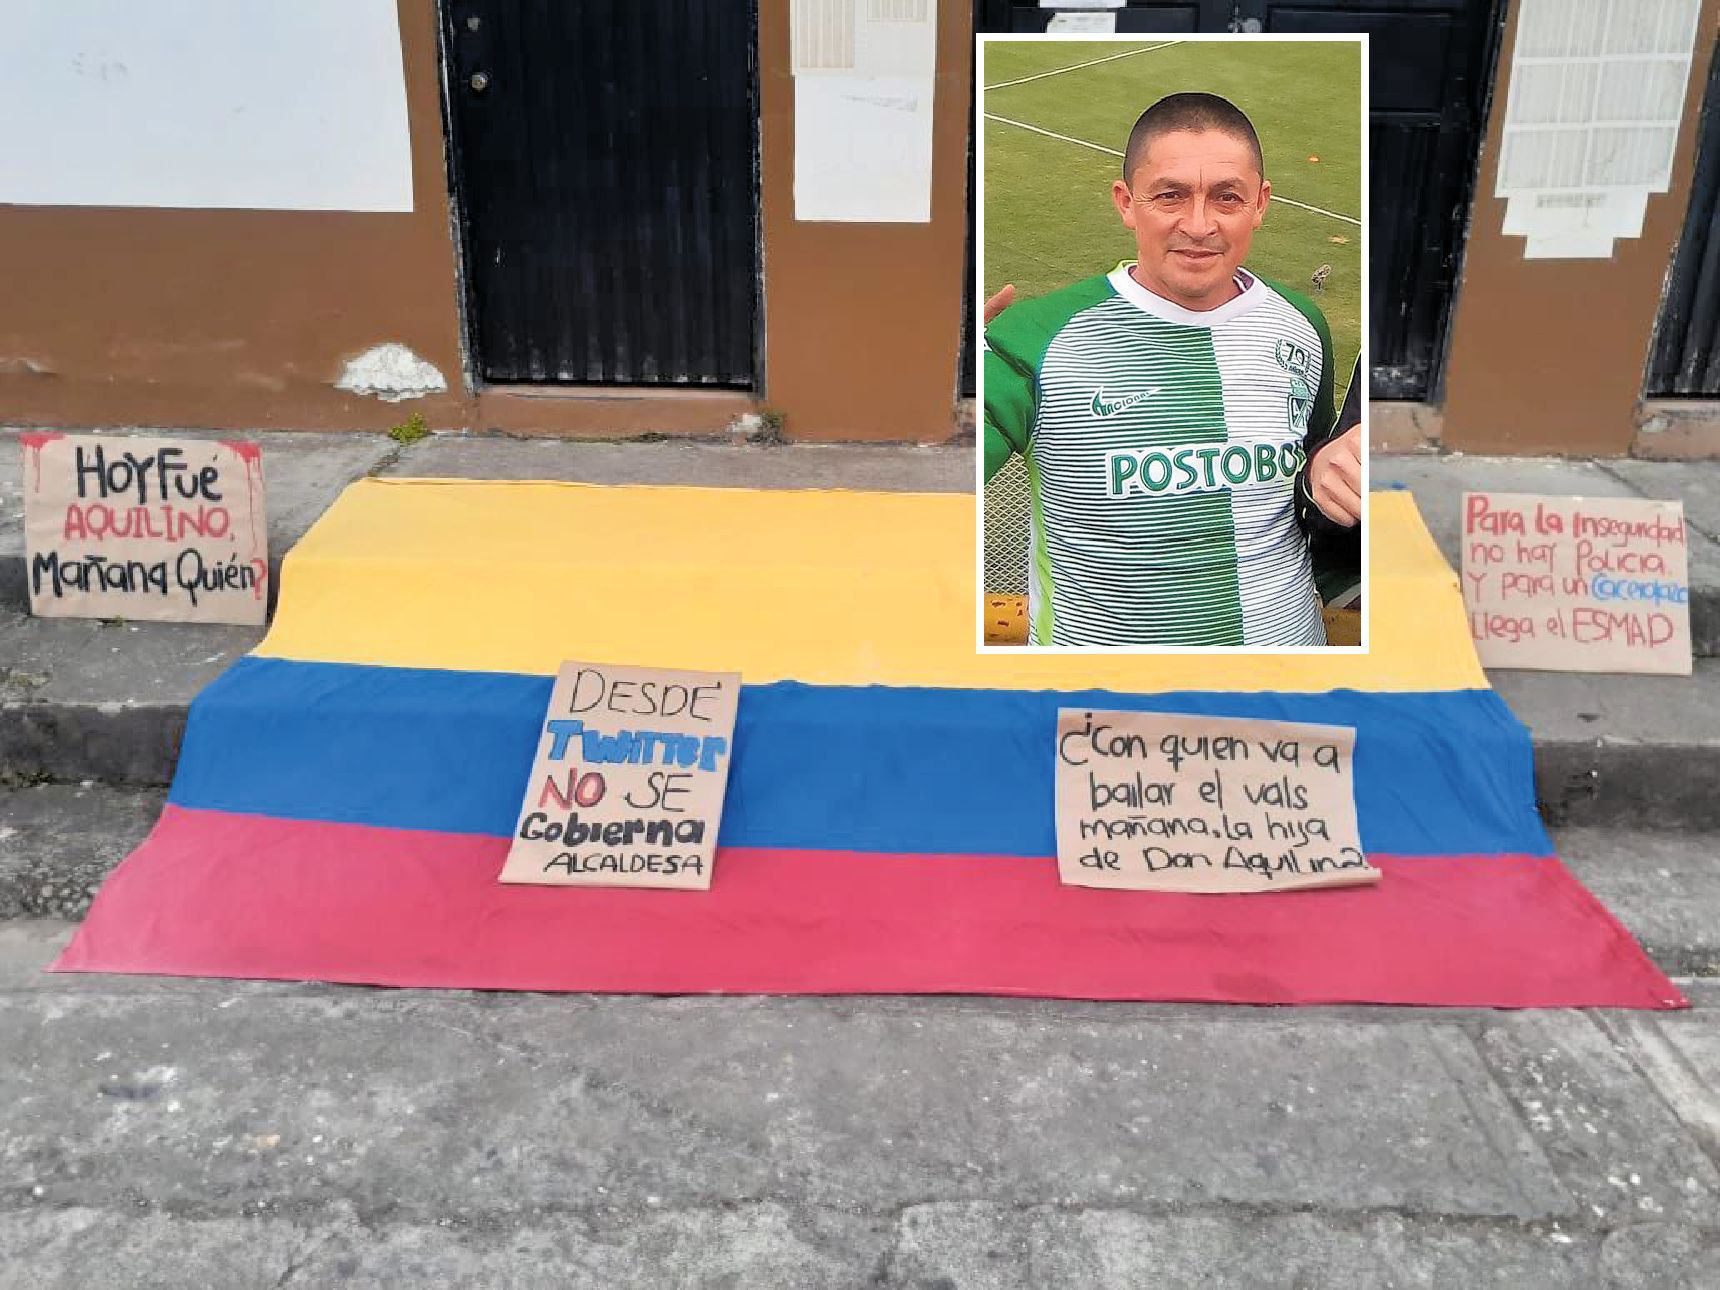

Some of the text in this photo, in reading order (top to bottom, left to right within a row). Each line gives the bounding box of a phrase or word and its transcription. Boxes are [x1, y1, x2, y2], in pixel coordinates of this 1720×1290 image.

[1467, 495, 1526, 536] Para
[1470, 542, 1504, 566] no
[32, 551, 168, 597] Mañana
[1562, 577, 1588, 597] un
[1546, 608, 1566, 638] el
[1573, 607, 1675, 648] ESMAD
[570, 668, 722, 722] DESDE
[1159, 734, 1249, 772] quien
[1258, 739, 1300, 768] va
[1313, 744, 1340, 773] a
[538, 768, 693, 812] NO SE
[1089, 768, 1309, 811] bailar el vals
[519, 812, 706, 847] Gobierna
[1264, 811, 1330, 848] hija
[543, 852, 703, 875] ALCALDESA
[1080, 847, 1121, 871] de
[1143, 846, 1213, 872] Don
